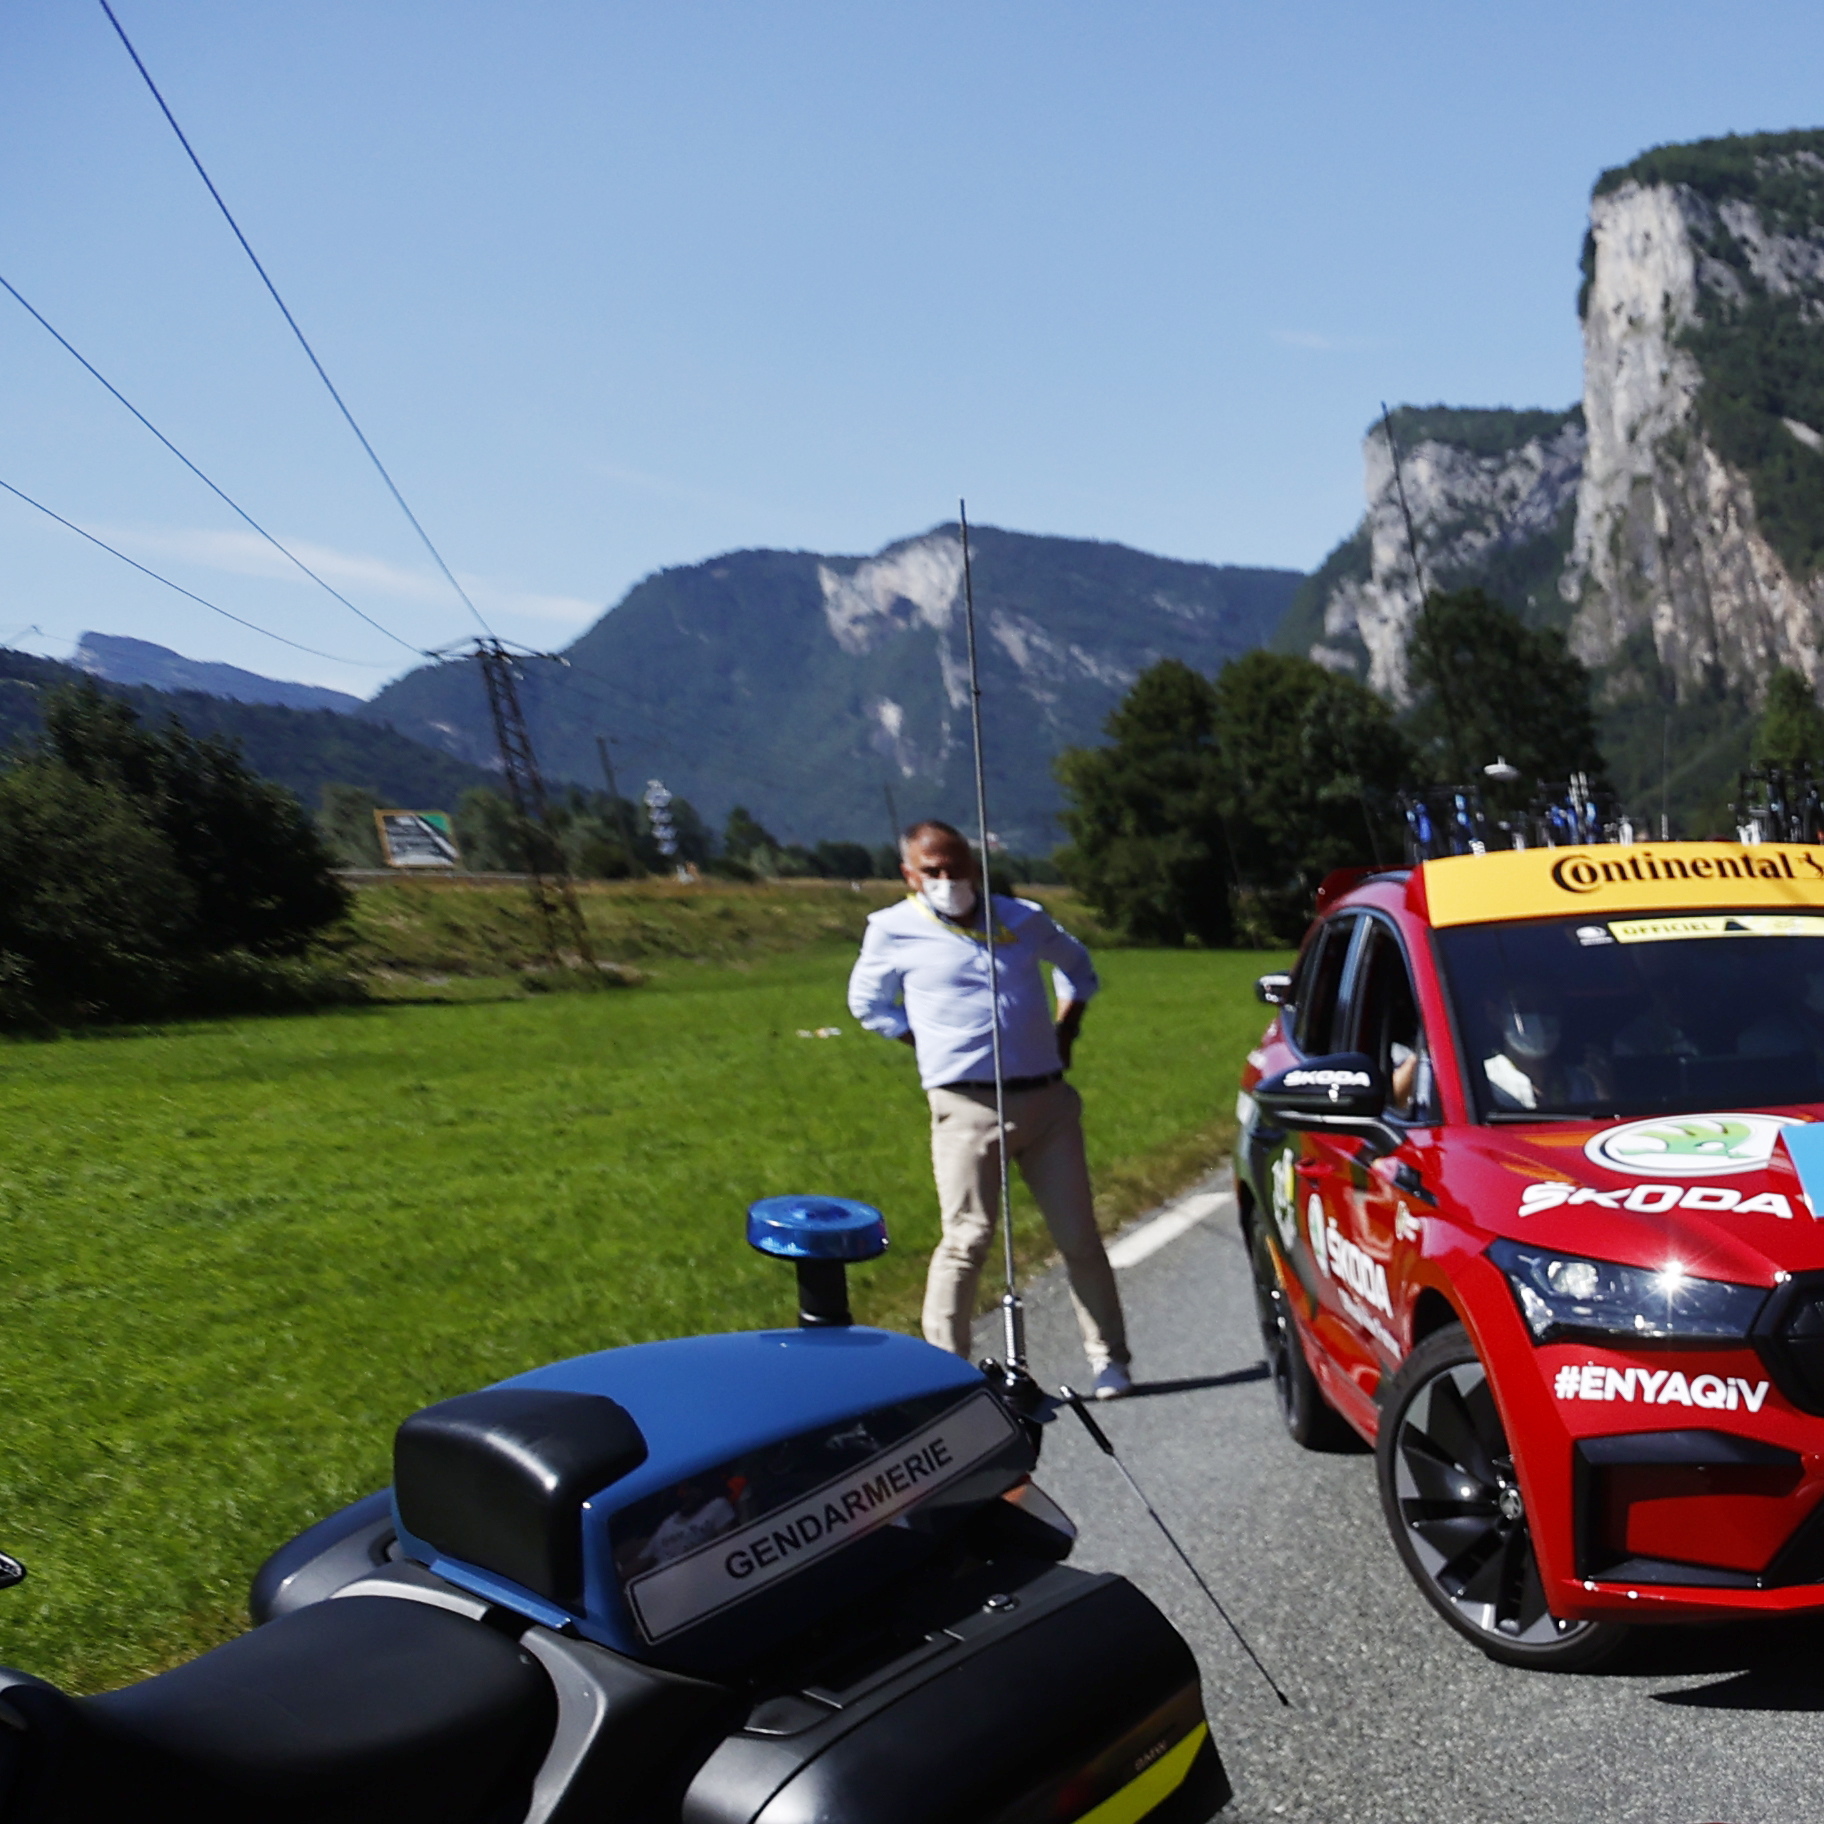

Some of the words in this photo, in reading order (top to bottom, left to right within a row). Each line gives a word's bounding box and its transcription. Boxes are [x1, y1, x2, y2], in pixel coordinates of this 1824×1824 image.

[1551, 851, 1796, 894] Continental
[1518, 1181, 1793, 1219] ŠKODA
[725, 1437, 954, 1581] GENDARMERIE
